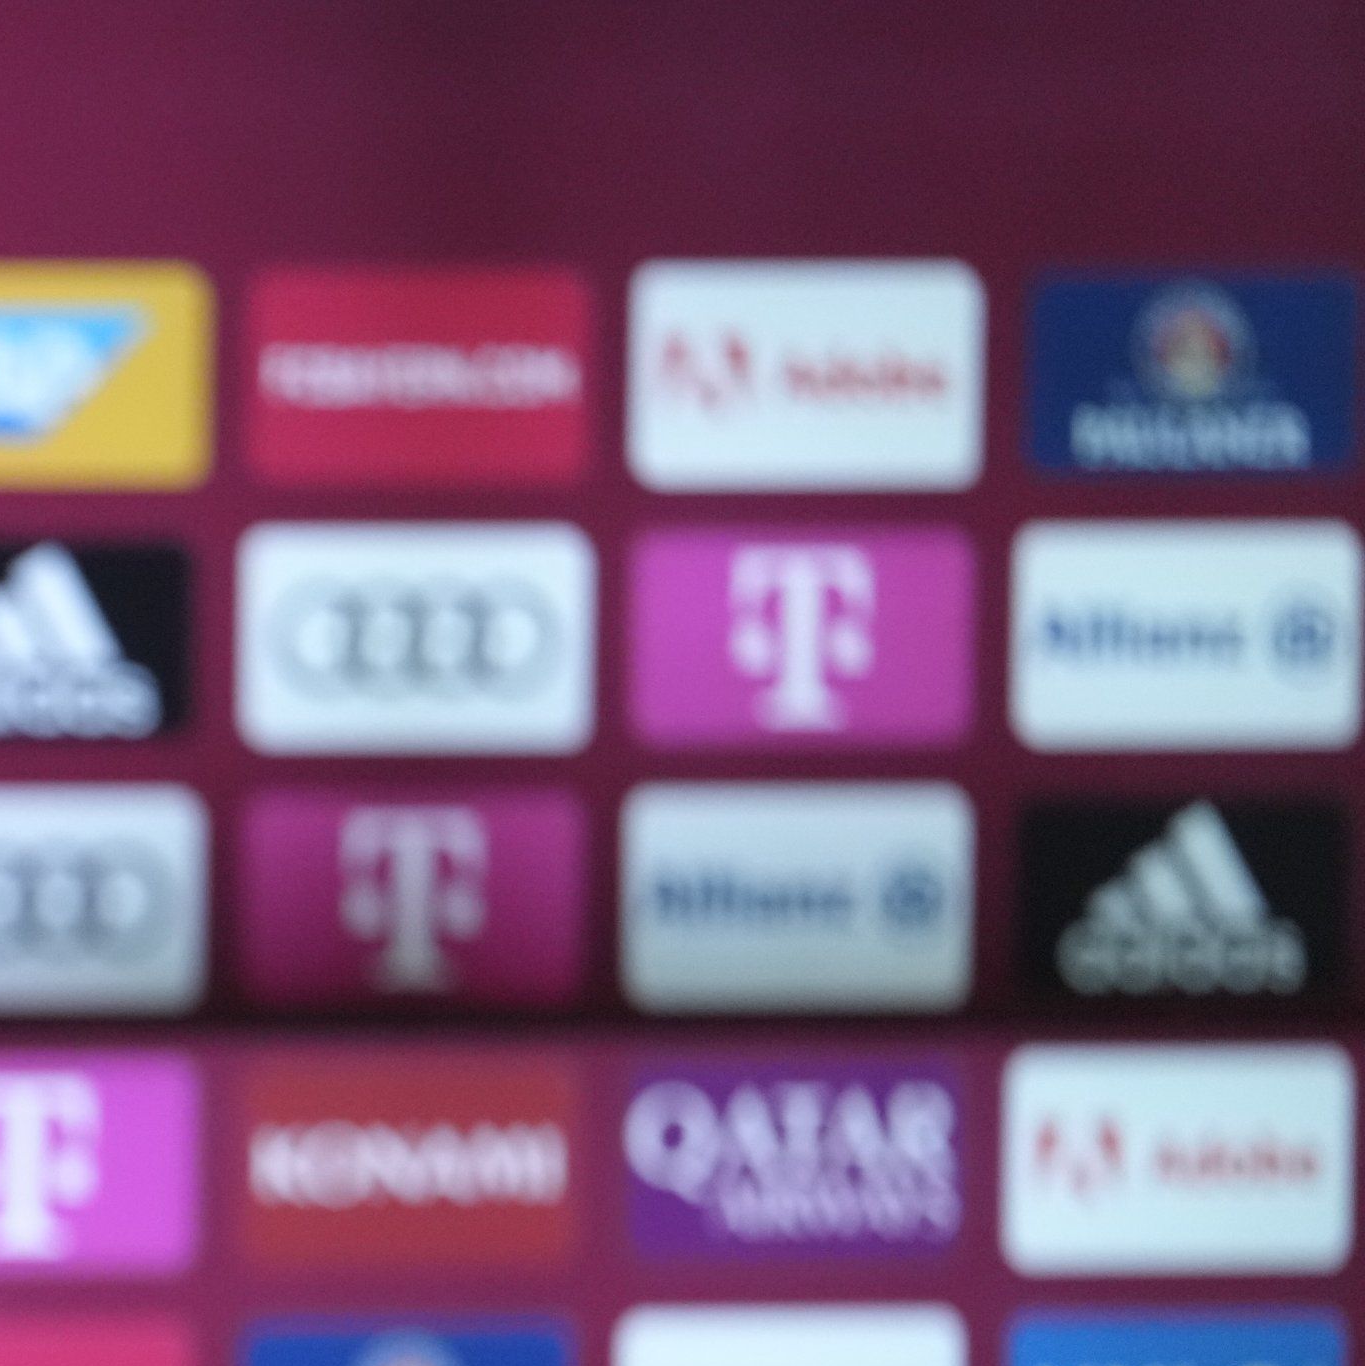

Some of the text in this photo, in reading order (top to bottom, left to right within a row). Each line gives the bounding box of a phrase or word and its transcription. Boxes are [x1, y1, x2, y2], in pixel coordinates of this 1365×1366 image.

[1041, 607, 1240, 667] Allianz
[650, 873, 851, 928] Allianz
[1059, 918, 1306, 995] adidas
[248, 1121, 567, 1208] KONAMI
[623, 1079, 957, 1192] QATAR
